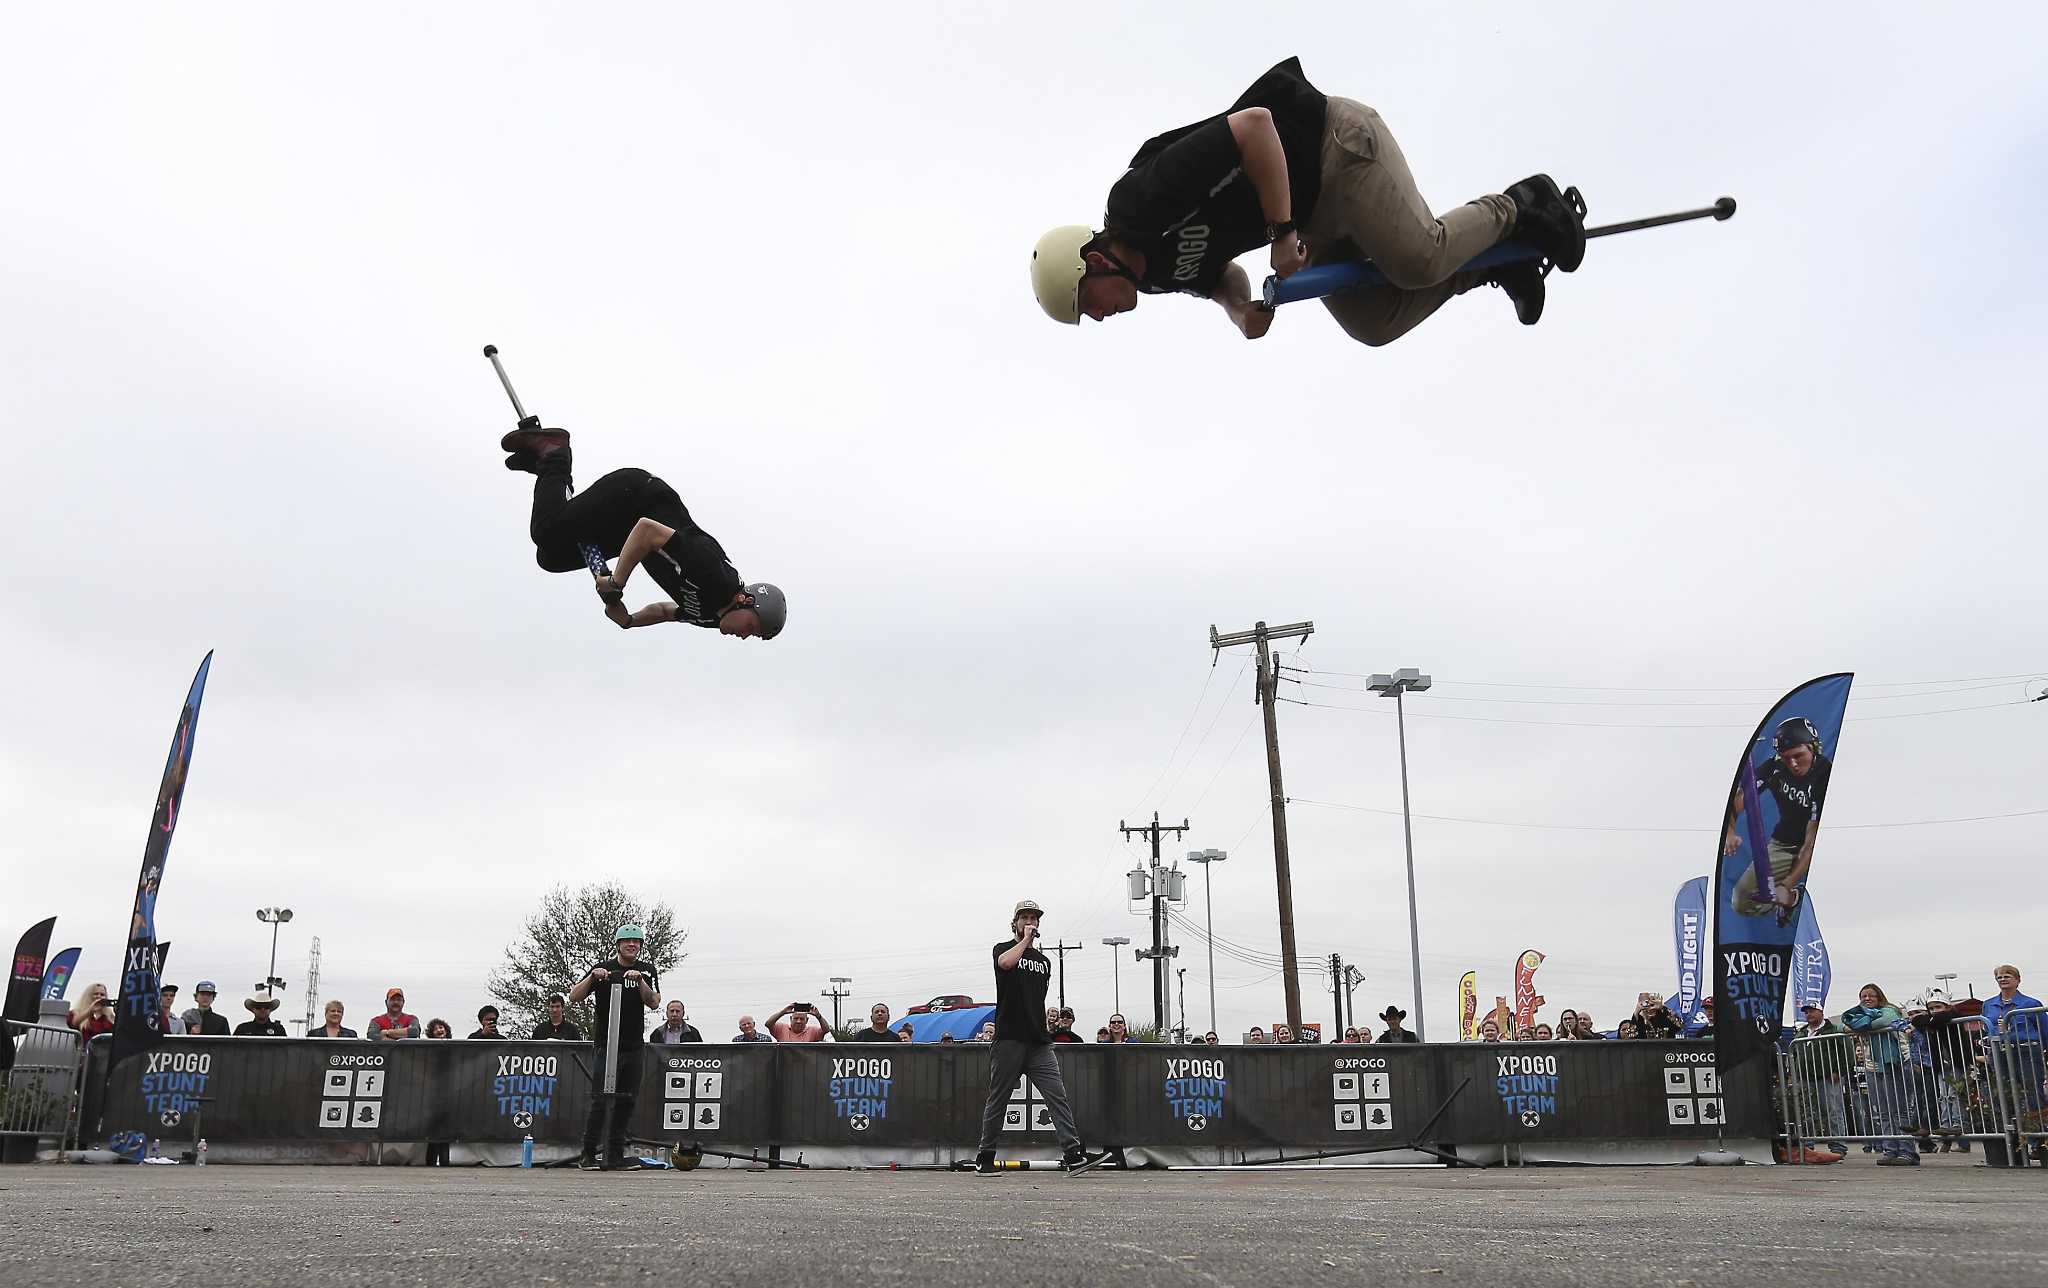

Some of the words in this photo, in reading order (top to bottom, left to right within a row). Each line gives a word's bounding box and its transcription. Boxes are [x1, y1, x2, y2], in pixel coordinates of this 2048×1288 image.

[1682, 913, 1698, 971] LIGHT
[1724, 952, 1782, 977] XPOGO
[1681, 972, 1697, 1014] BUD
[1727, 975, 1783, 998] STUNT
[1734, 998, 1780, 1020] TEAM
[147, 1053, 211, 1074] XPOGO
[329, 1055, 384, 1066] @XPOGO
[497, 1055, 558, 1077] XPOGO
[668, 1058, 722, 1069] @XPOGO
[831, 1058, 892, 1079] XPOGO
[1166, 1058, 1225, 1079] XPOGO
[1334, 1058, 1386, 1069] @XPOGO
[1496, 1055, 1557, 1076] XPOGO
[142, 1073, 209, 1093] STUNT
[493, 1076, 558, 1096] STUNT
[829, 1078, 893, 1098] STUNT
[1165, 1078, 1227, 1098] STUNT
[1496, 1075, 1559, 1095] STUNT
[145, 1094, 200, 1113] TEAM
[497, 1096, 550, 1116] TEAM
[833, 1098, 887, 1118] TEAM
[1169, 1098, 1223, 1118] TEAM
[1502, 1095, 1556, 1114] TEAM
